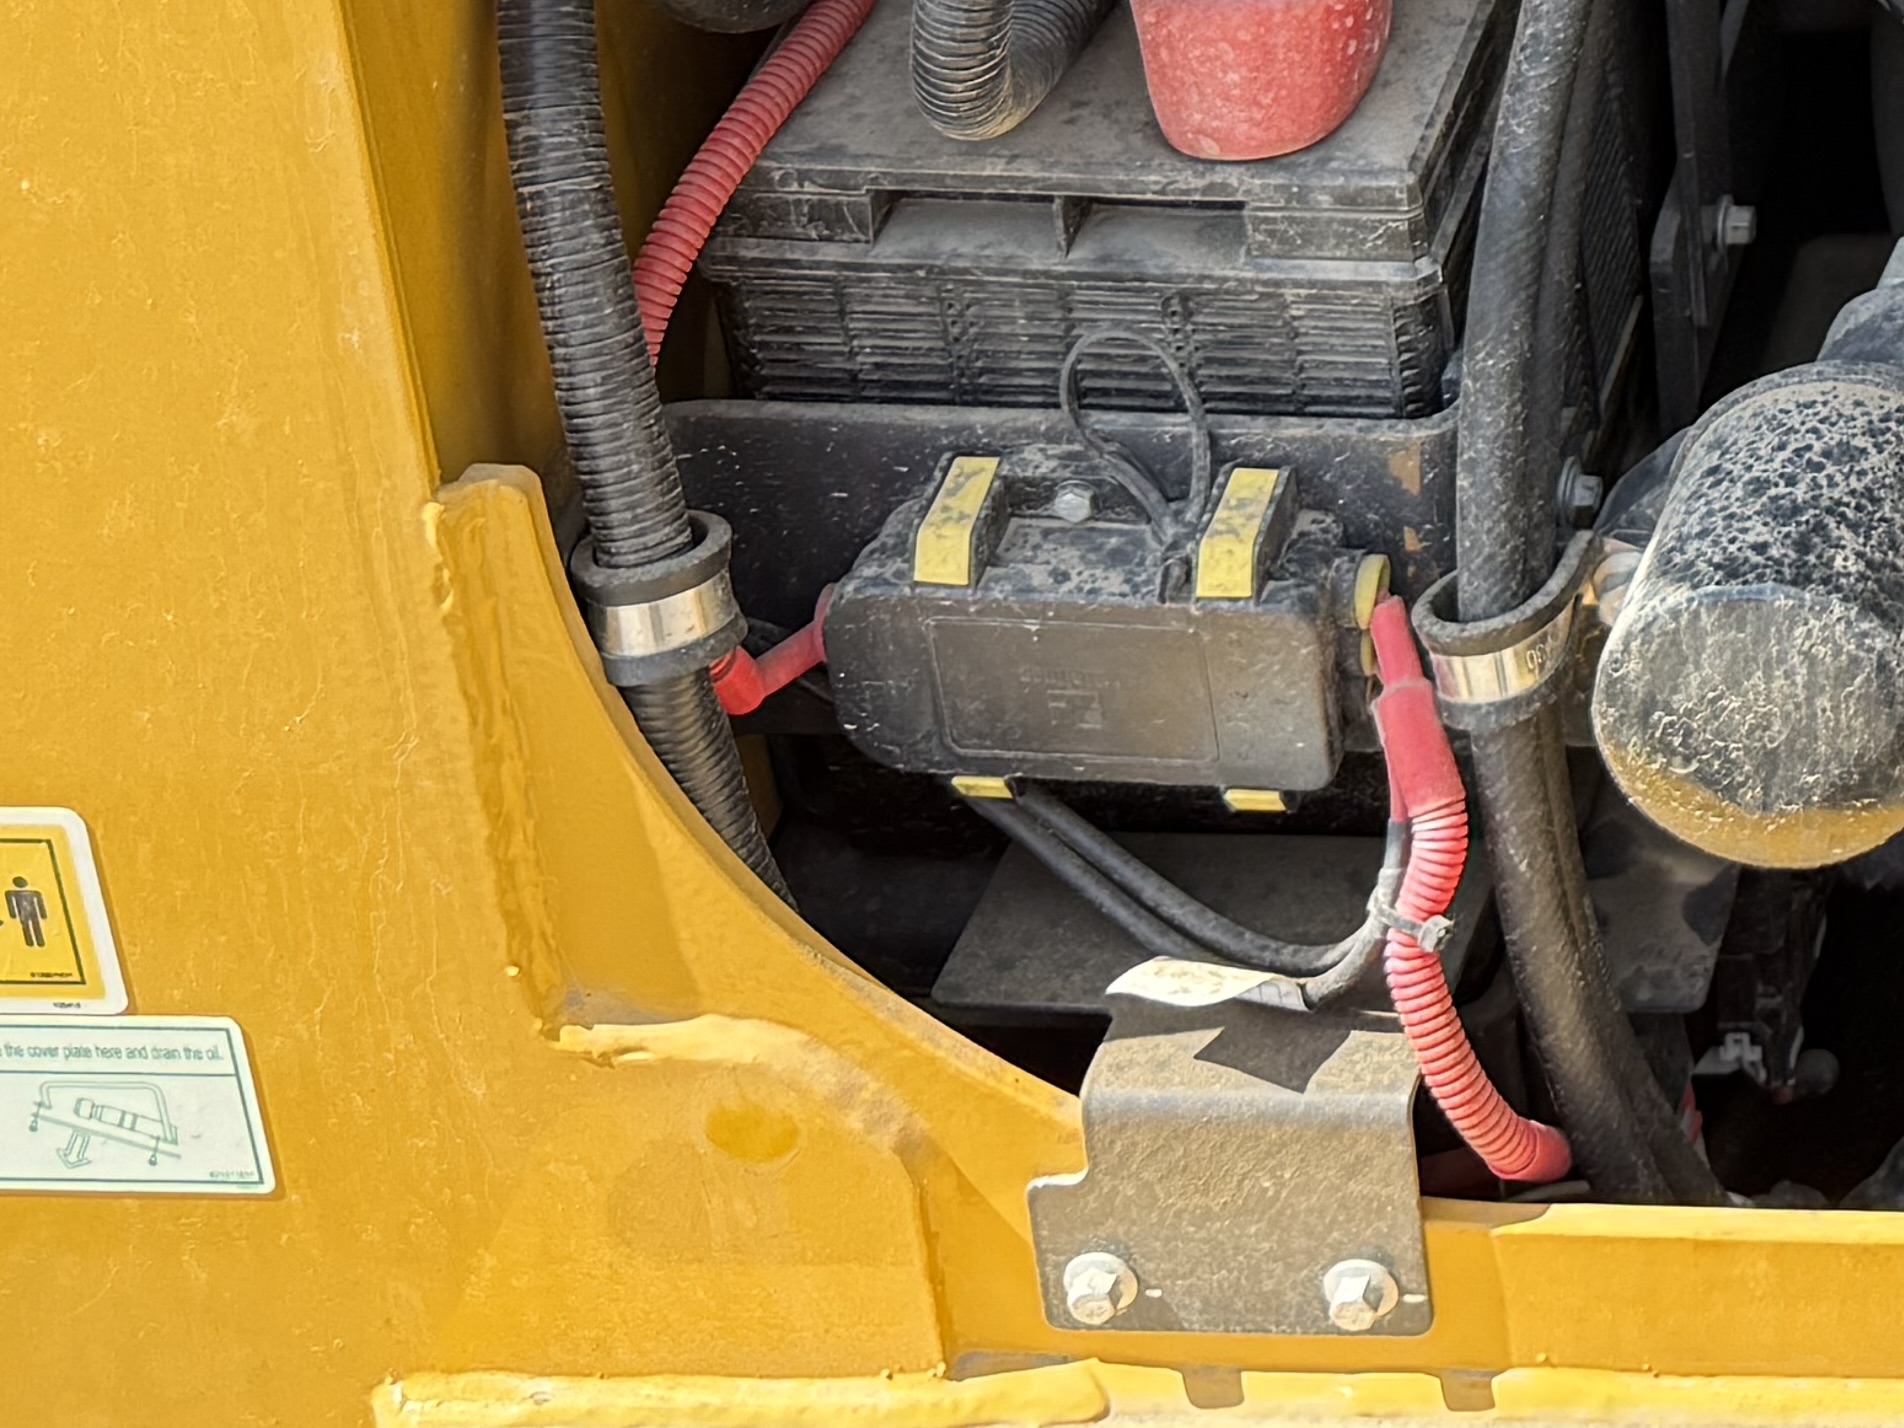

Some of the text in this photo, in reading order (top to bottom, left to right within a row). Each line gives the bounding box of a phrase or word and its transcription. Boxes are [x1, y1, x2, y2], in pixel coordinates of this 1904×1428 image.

[27, 1046, 59, 1058] cover
[63, 1044, 93, 1061] plate
[94, 1044, 122, 1059] here
[126, 1046, 149, 1060] and
[151, 1046, 181, 1060] drain
[183, 1047, 203, 1060] the
